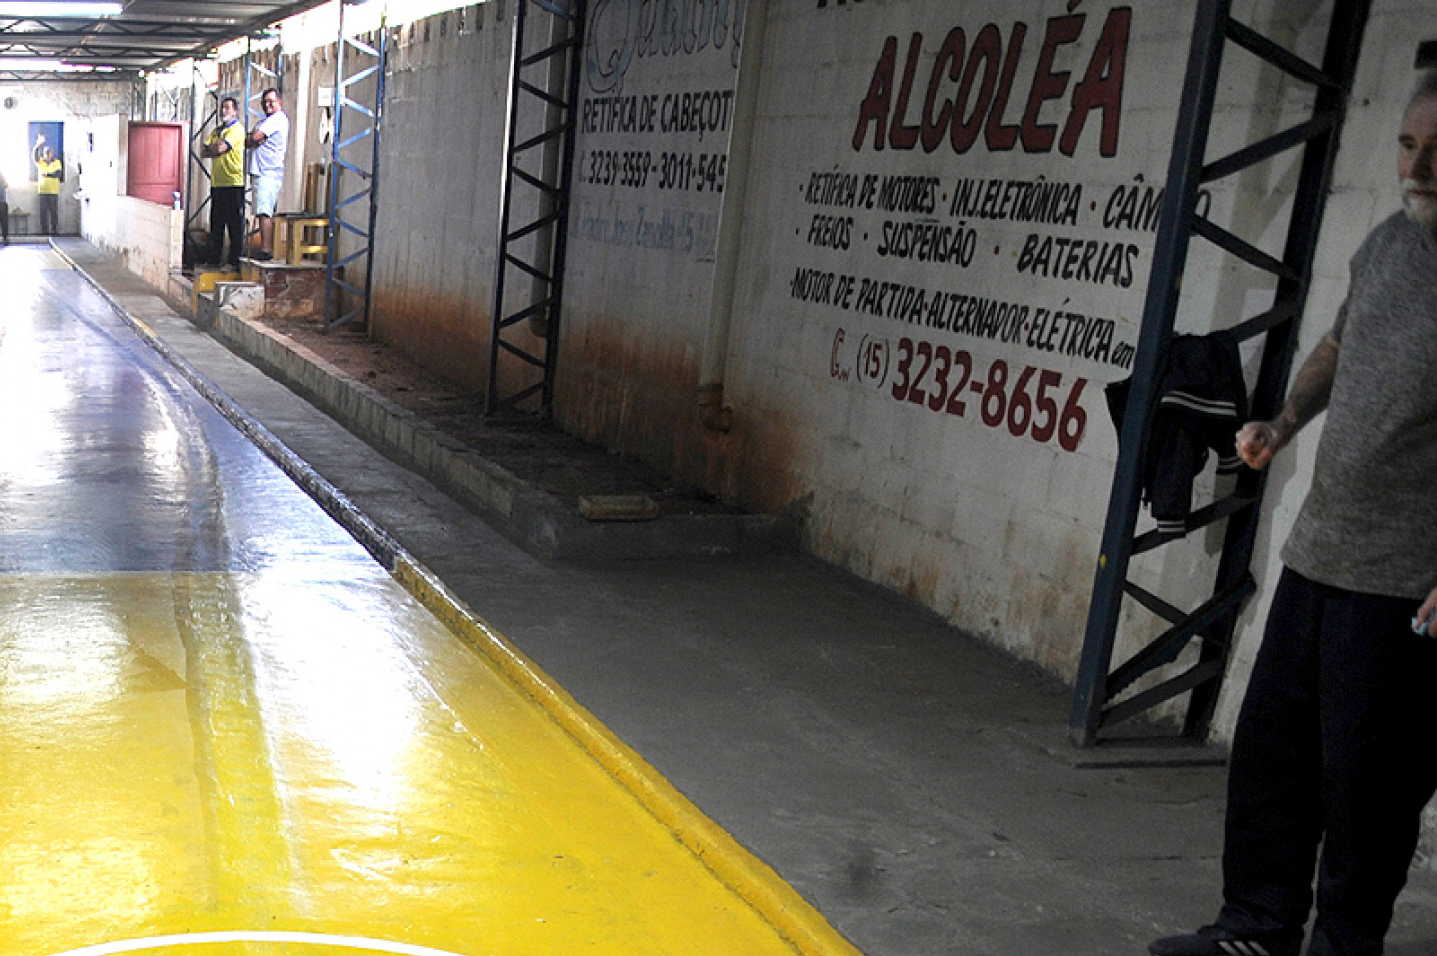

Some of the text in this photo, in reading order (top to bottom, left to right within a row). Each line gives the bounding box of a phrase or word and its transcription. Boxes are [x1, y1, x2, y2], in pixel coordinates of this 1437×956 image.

[639, 95, 658, 131] DE
[852, 0, 1132, 158] ALCOLÉA
[857, 173, 877, 210] DE
[878, 175, 940, 215] MOTORES
[807, 213, 1139, 288] FREIOS SUSPENSÃO BATERIAS
[792, 267, 835, 303] MOTOR
[835, 276, 855, 308] DE
[855, 278, 925, 326] PARTIDA
[928, 290, 1030, 344] ALTERNADOR
[1029, 297, 1116, 363] ELÉTRICA
[856, 333, 1088, 452] (15) 3232-8656
